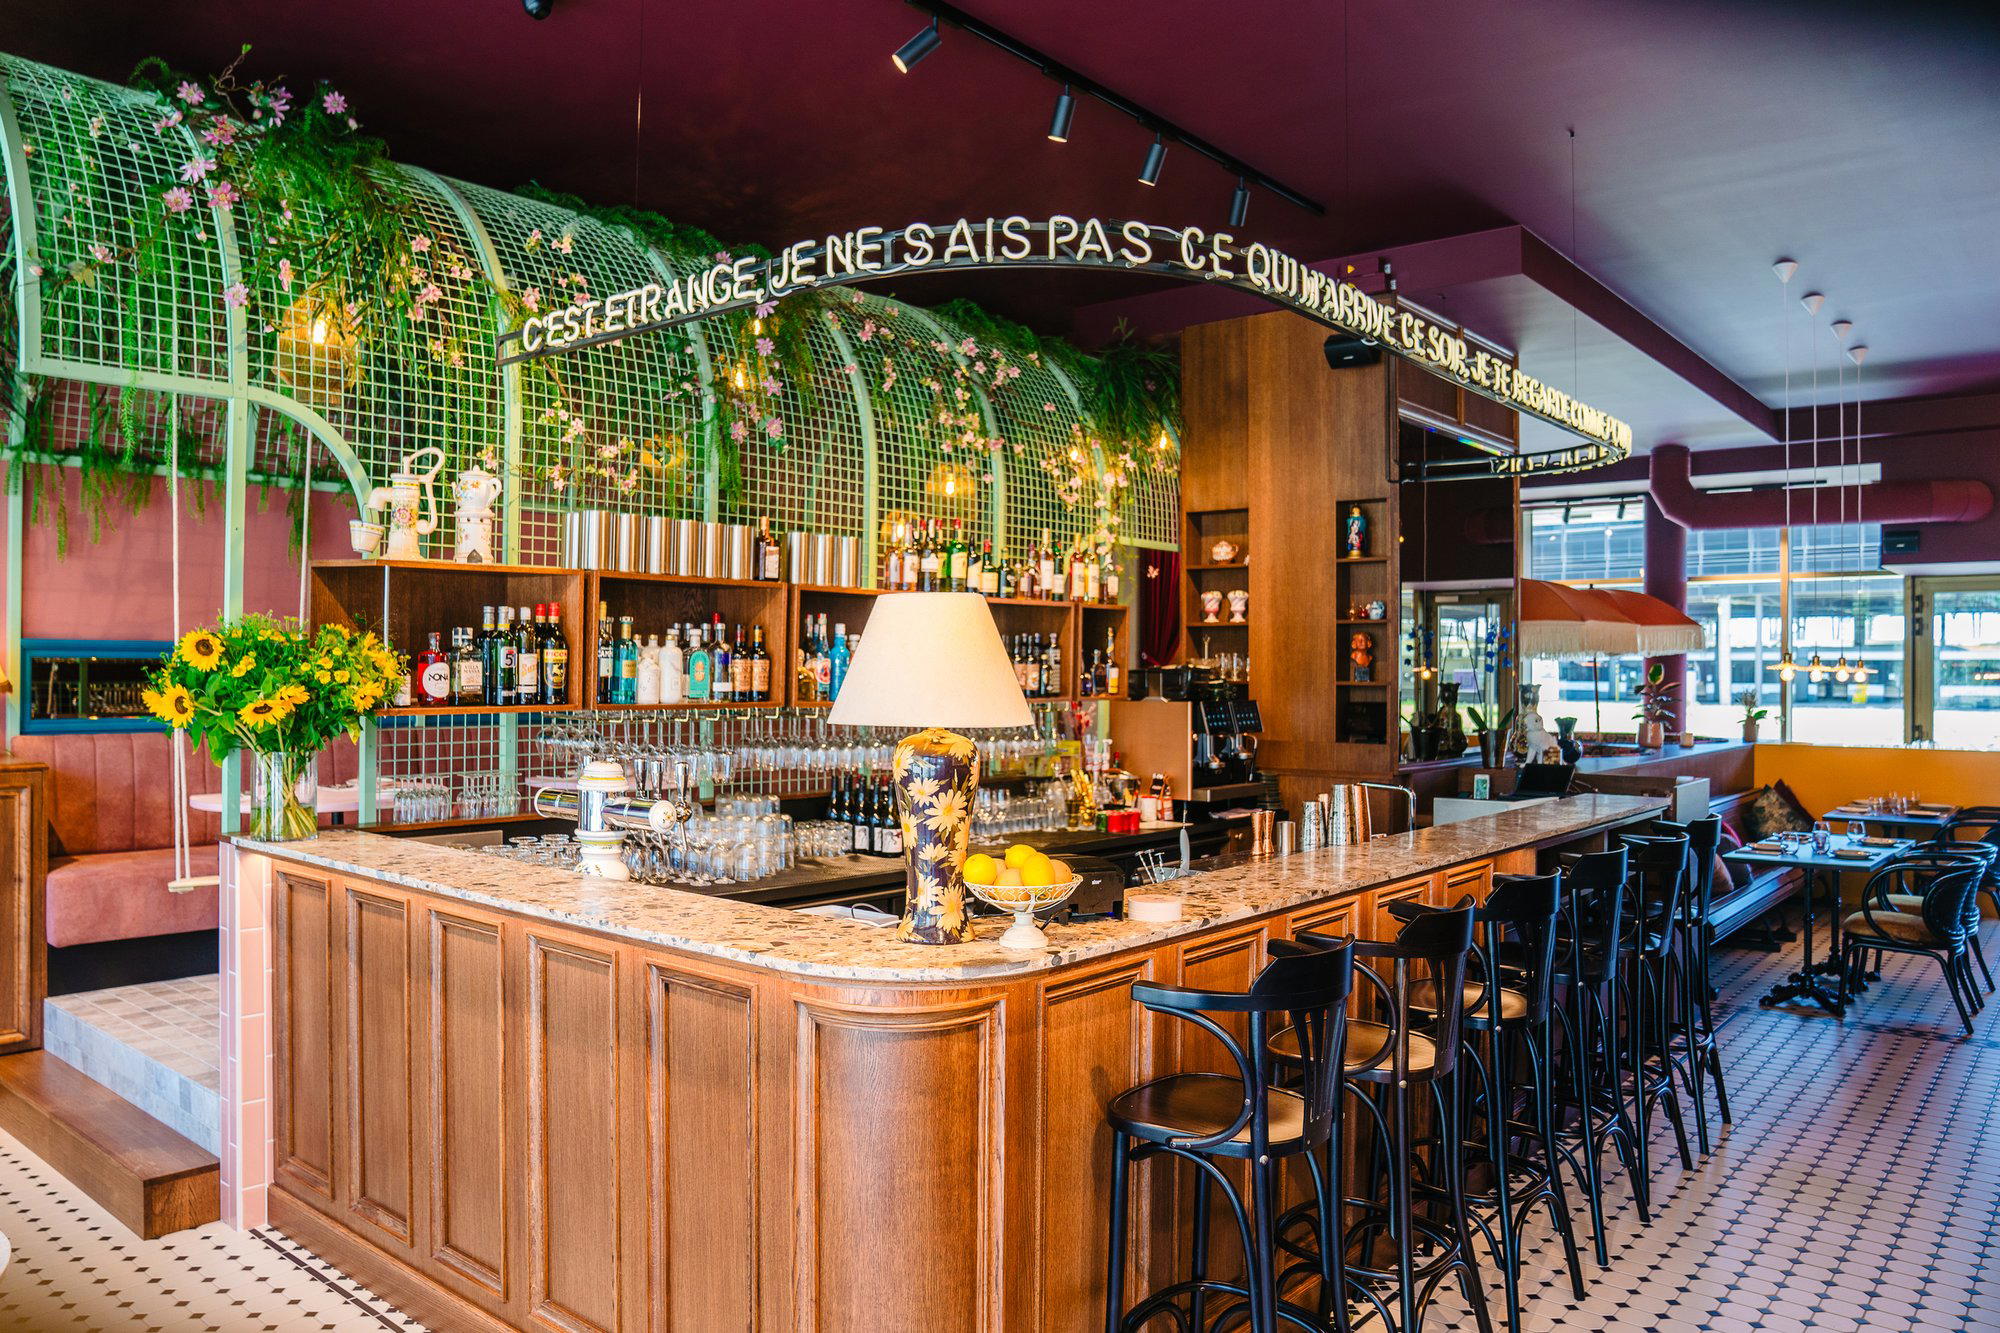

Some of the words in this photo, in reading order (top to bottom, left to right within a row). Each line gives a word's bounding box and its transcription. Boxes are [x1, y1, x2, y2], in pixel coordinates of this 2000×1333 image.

[523, 300, 600, 352] C'EST
[771, 240, 817, 289] JE
[826, 226, 884, 279] NE
[903, 216, 1032, 267] SAIS
[1048, 215, 1153, 265] PAS
[1181, 226, 1234, 280] CE
[1247, 243, 1298, 297] QUI
[1401, 312, 1427, 356] CE
